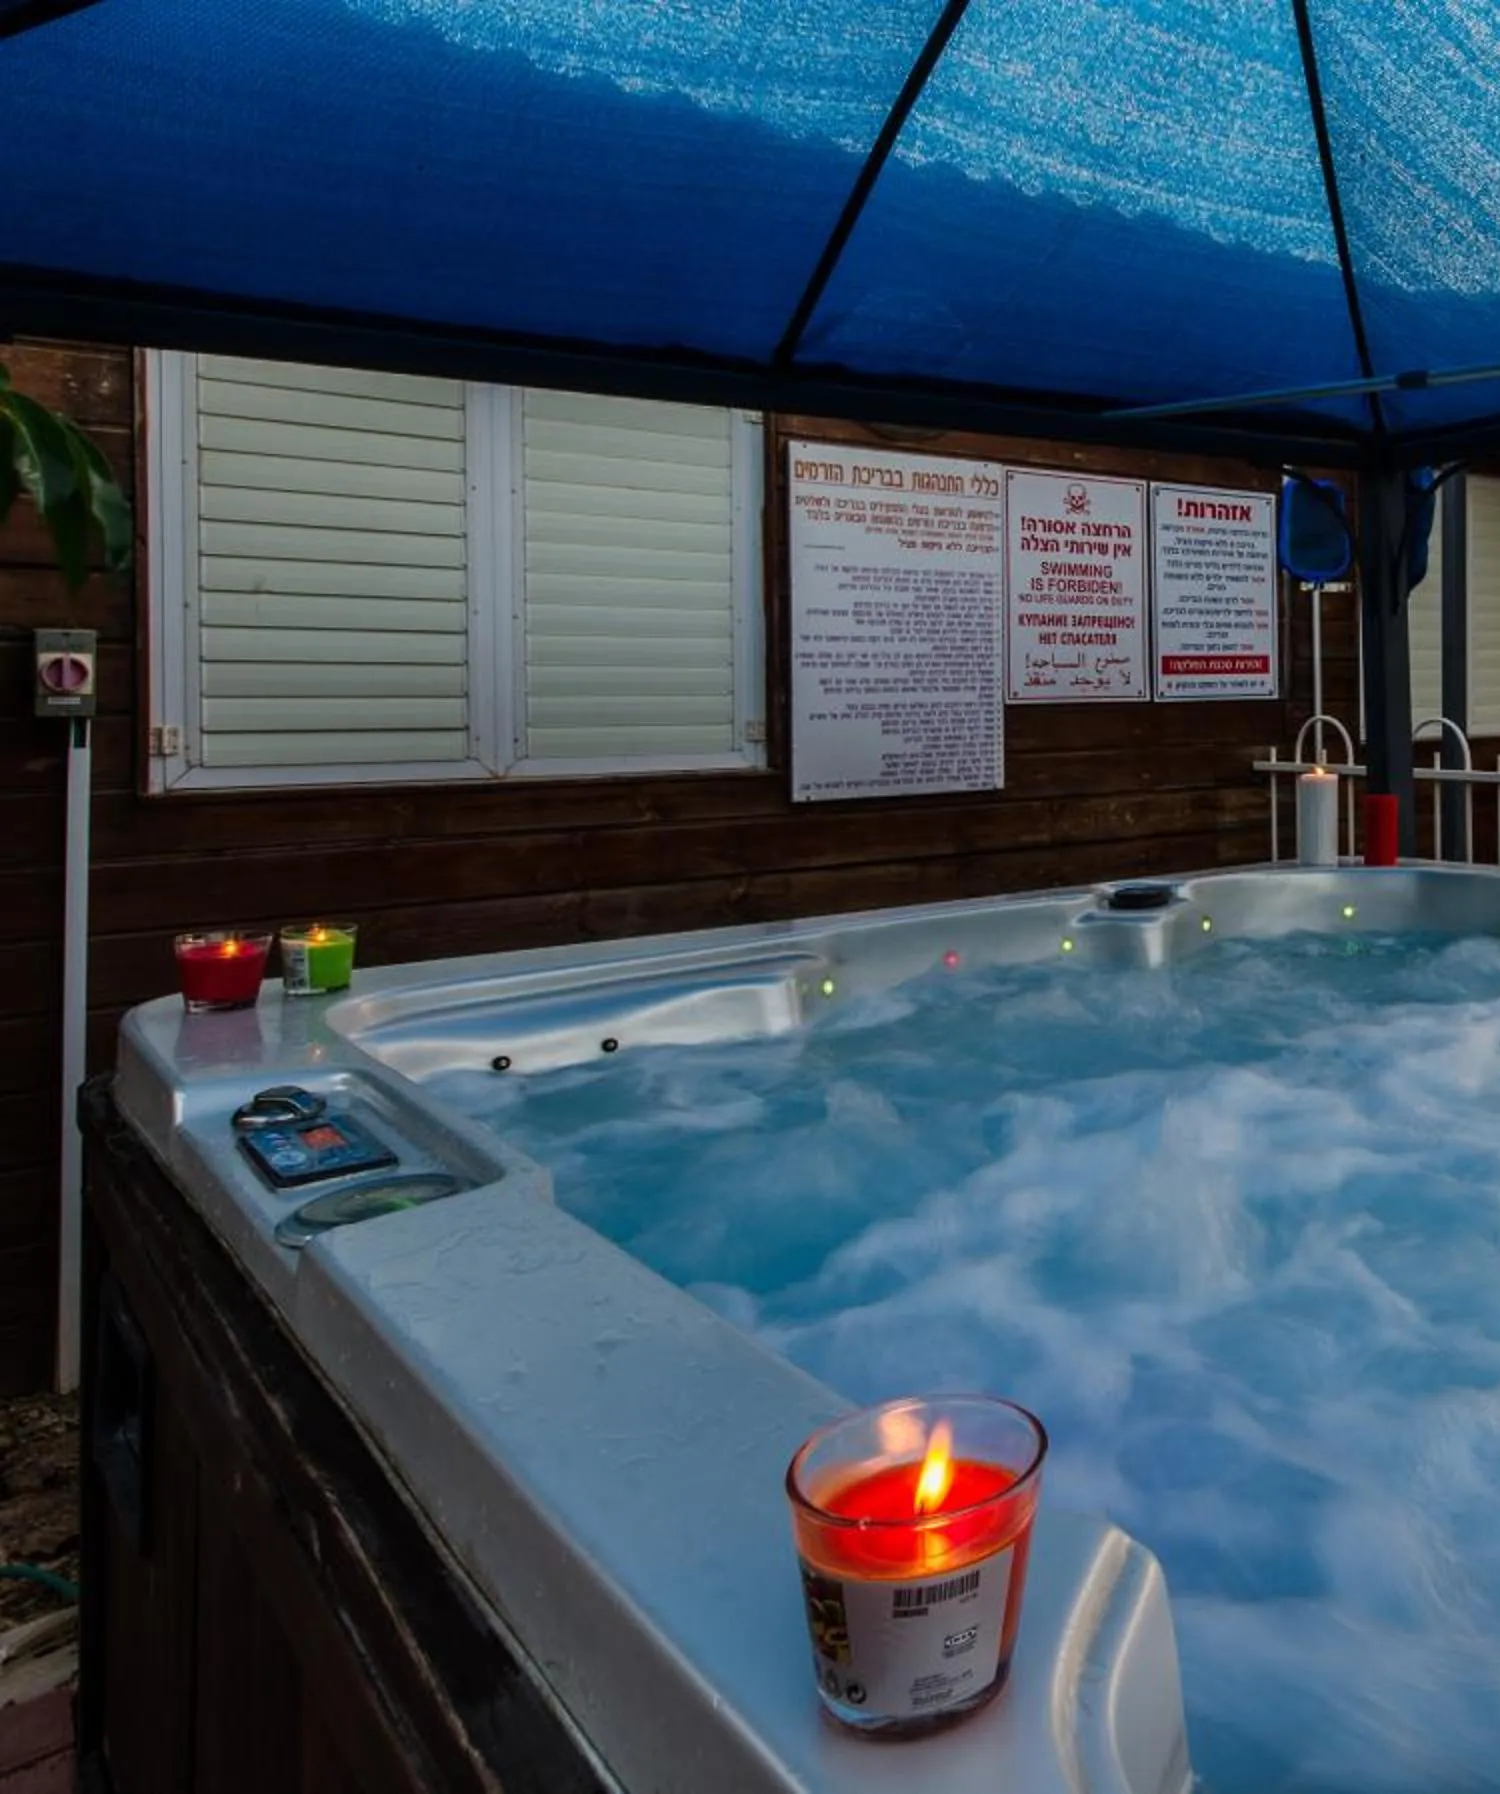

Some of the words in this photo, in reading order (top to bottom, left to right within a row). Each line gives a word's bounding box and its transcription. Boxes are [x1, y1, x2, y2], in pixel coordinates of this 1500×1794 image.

[794, 460, 843, 482] הזרמים
[852, 465, 903, 488] בבריכת
[911, 471, 964, 494] התנהגות
[970, 472, 999, 496] כללי
[1178, 497, 1252, 522] אזהרות!
[1021, 516, 1076, 534] אסורה!
[1081, 522, 1131, 538] הרחצה
[1021, 535, 1060, 552] הצלה
[1064, 539, 1108, 556] שירותי
[1114, 542, 1132, 559] אין
[1040, 562, 1113, 578] SWIMMING
[1031, 578, 1044, 591] IS
[1048, 579, 1123, 594] FORBIDEN!
[1018, 613, 1068, 627] КУПАНИЕ
[1039, 633, 1057, 645] НЕТ
[1060, 633, 1117, 646] СПАСАТЕЛЯ
